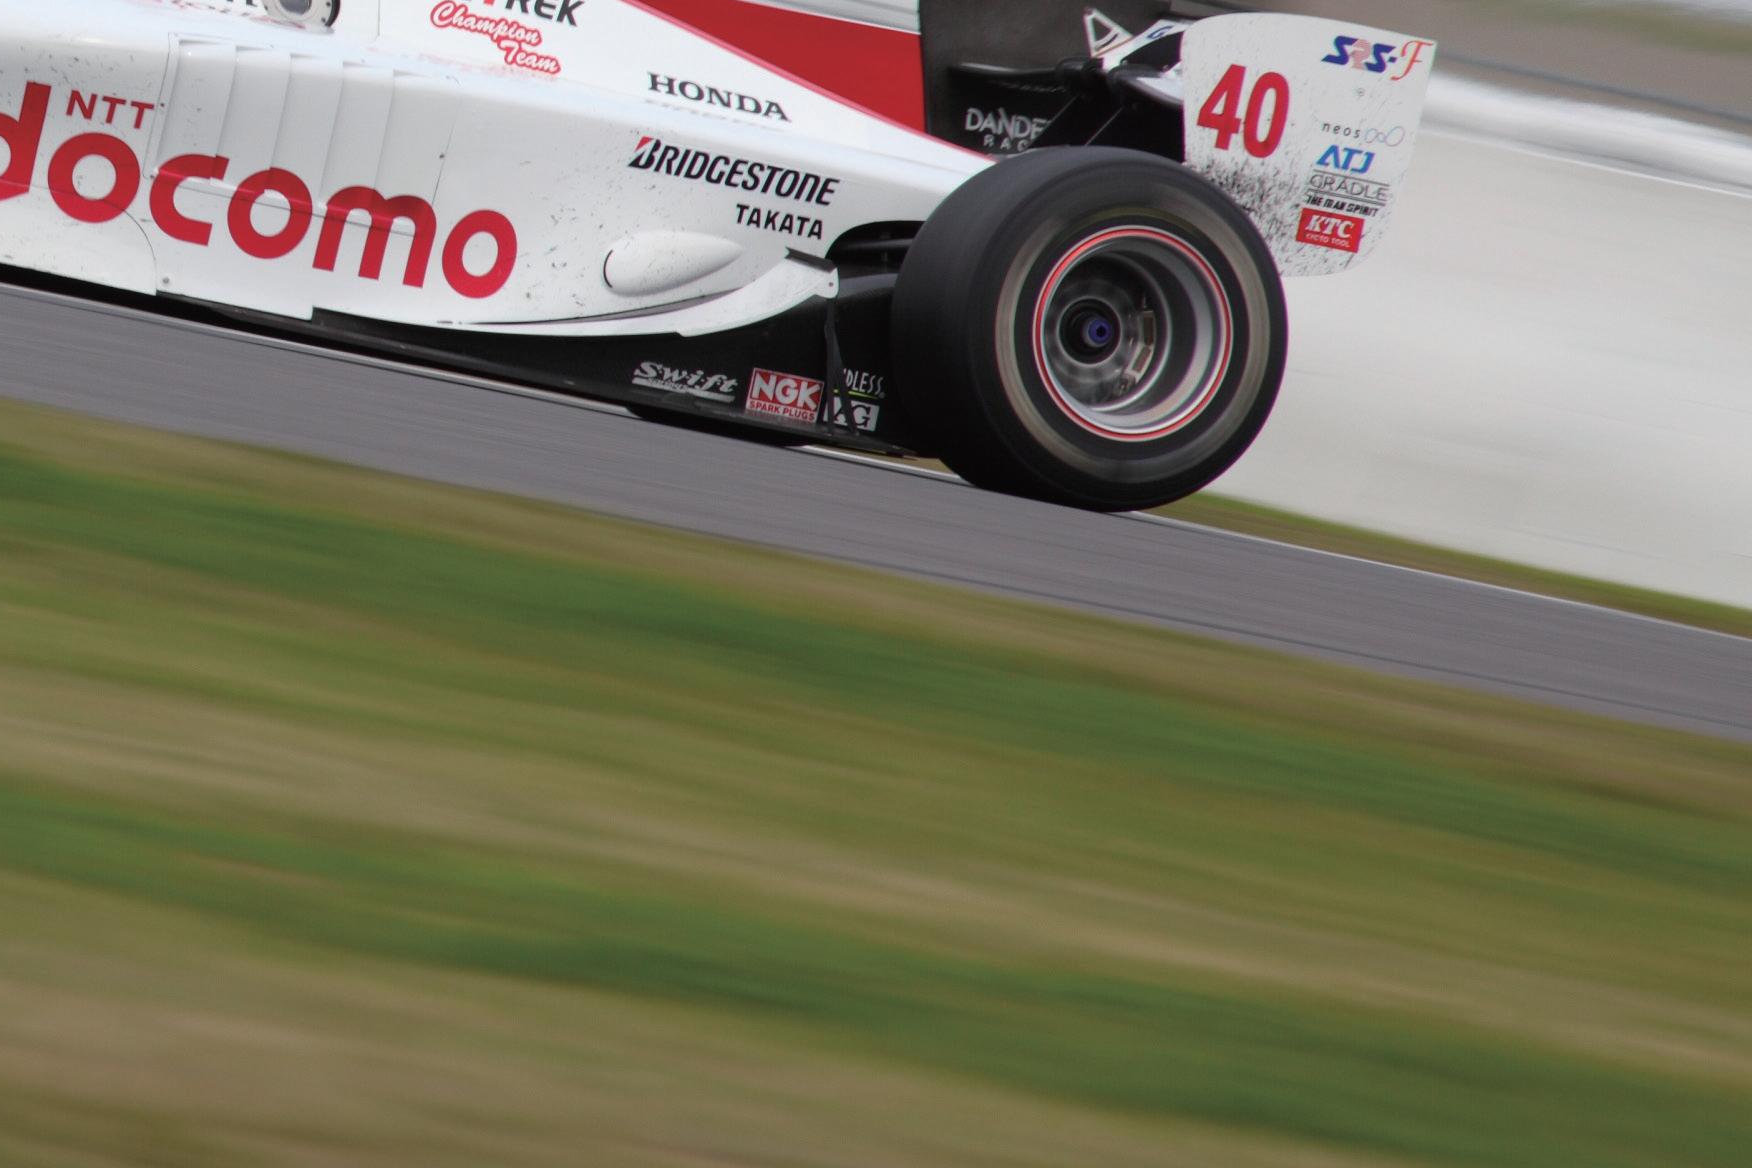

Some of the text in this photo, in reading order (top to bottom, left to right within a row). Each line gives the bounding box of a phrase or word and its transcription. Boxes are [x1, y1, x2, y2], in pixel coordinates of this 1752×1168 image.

[432, 0, 541, 45] Champion
[499, 37, 561, 73] Team
[66, 89, 154, 130] NTT
[647, 72, 792, 123] HONDA
[1196, 63, 1290, 159] 40
[1322, 122, 1361, 139] neos
[627, 135, 841, 206] BRIDGESTONE
[1315, 144, 1376, 174] ATJ
[736, 203, 824, 240] TAKATA
[1304, 214, 1355, 239] KTC
[751, 372, 821, 411] NGK
[843, 368, 884, 396] DLESS
[749, 399, 815, 422] SPARK PLUGS
